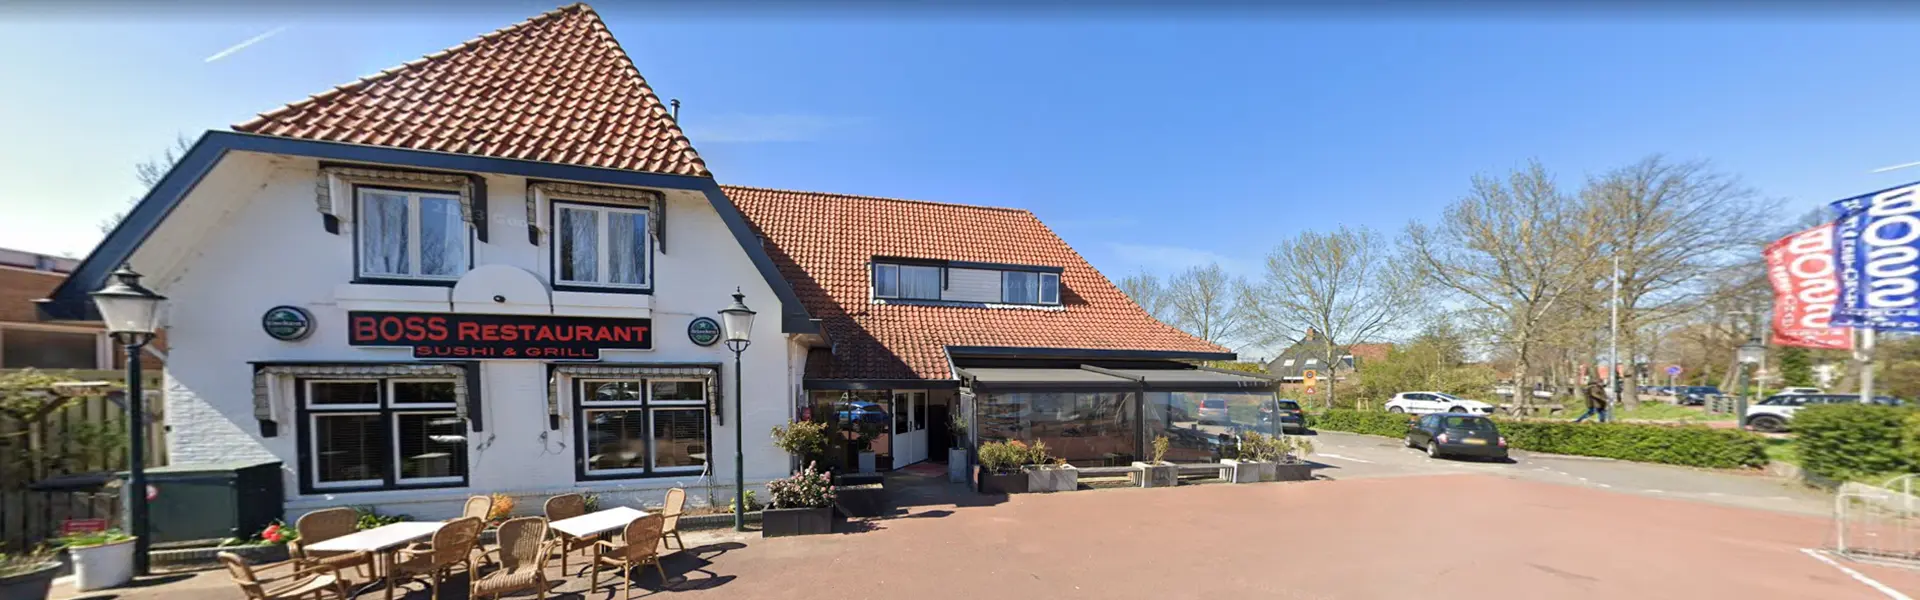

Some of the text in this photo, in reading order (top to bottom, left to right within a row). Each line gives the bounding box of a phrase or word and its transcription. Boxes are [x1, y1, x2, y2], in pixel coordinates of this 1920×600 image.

[354, 316, 648, 342] BOSS RESTAURANT
[415, 346, 595, 357] SUSHI & GRILL
